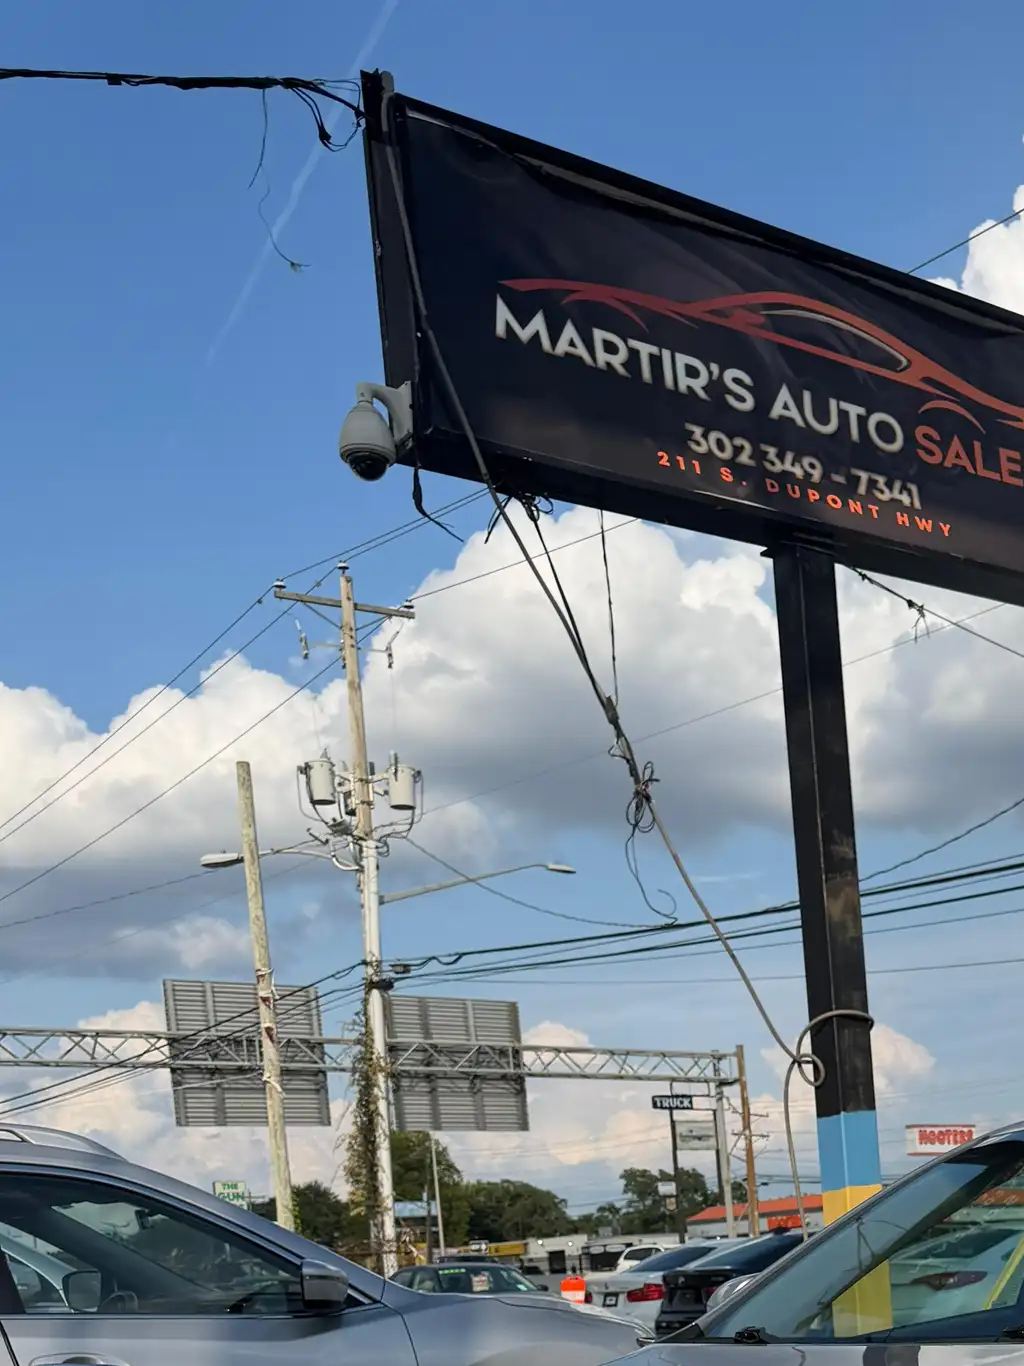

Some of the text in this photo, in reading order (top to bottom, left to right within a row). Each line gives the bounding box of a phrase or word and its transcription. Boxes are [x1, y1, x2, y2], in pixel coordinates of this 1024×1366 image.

[494, 294, 756, 413] MARTIR'S
[768, 383, 905, 454] AUTO
[684, 422, 757, 467] 302
[760, 443, 824, 485] 349
[850, 467, 922, 511] 7341
[656, 450, 951, 538] 211 S. DUPONT HWY
[654, 1097, 692, 1109] TRUCK
[217, 1192, 245, 1202] GUN
[221, 1182, 239, 1190] THE
